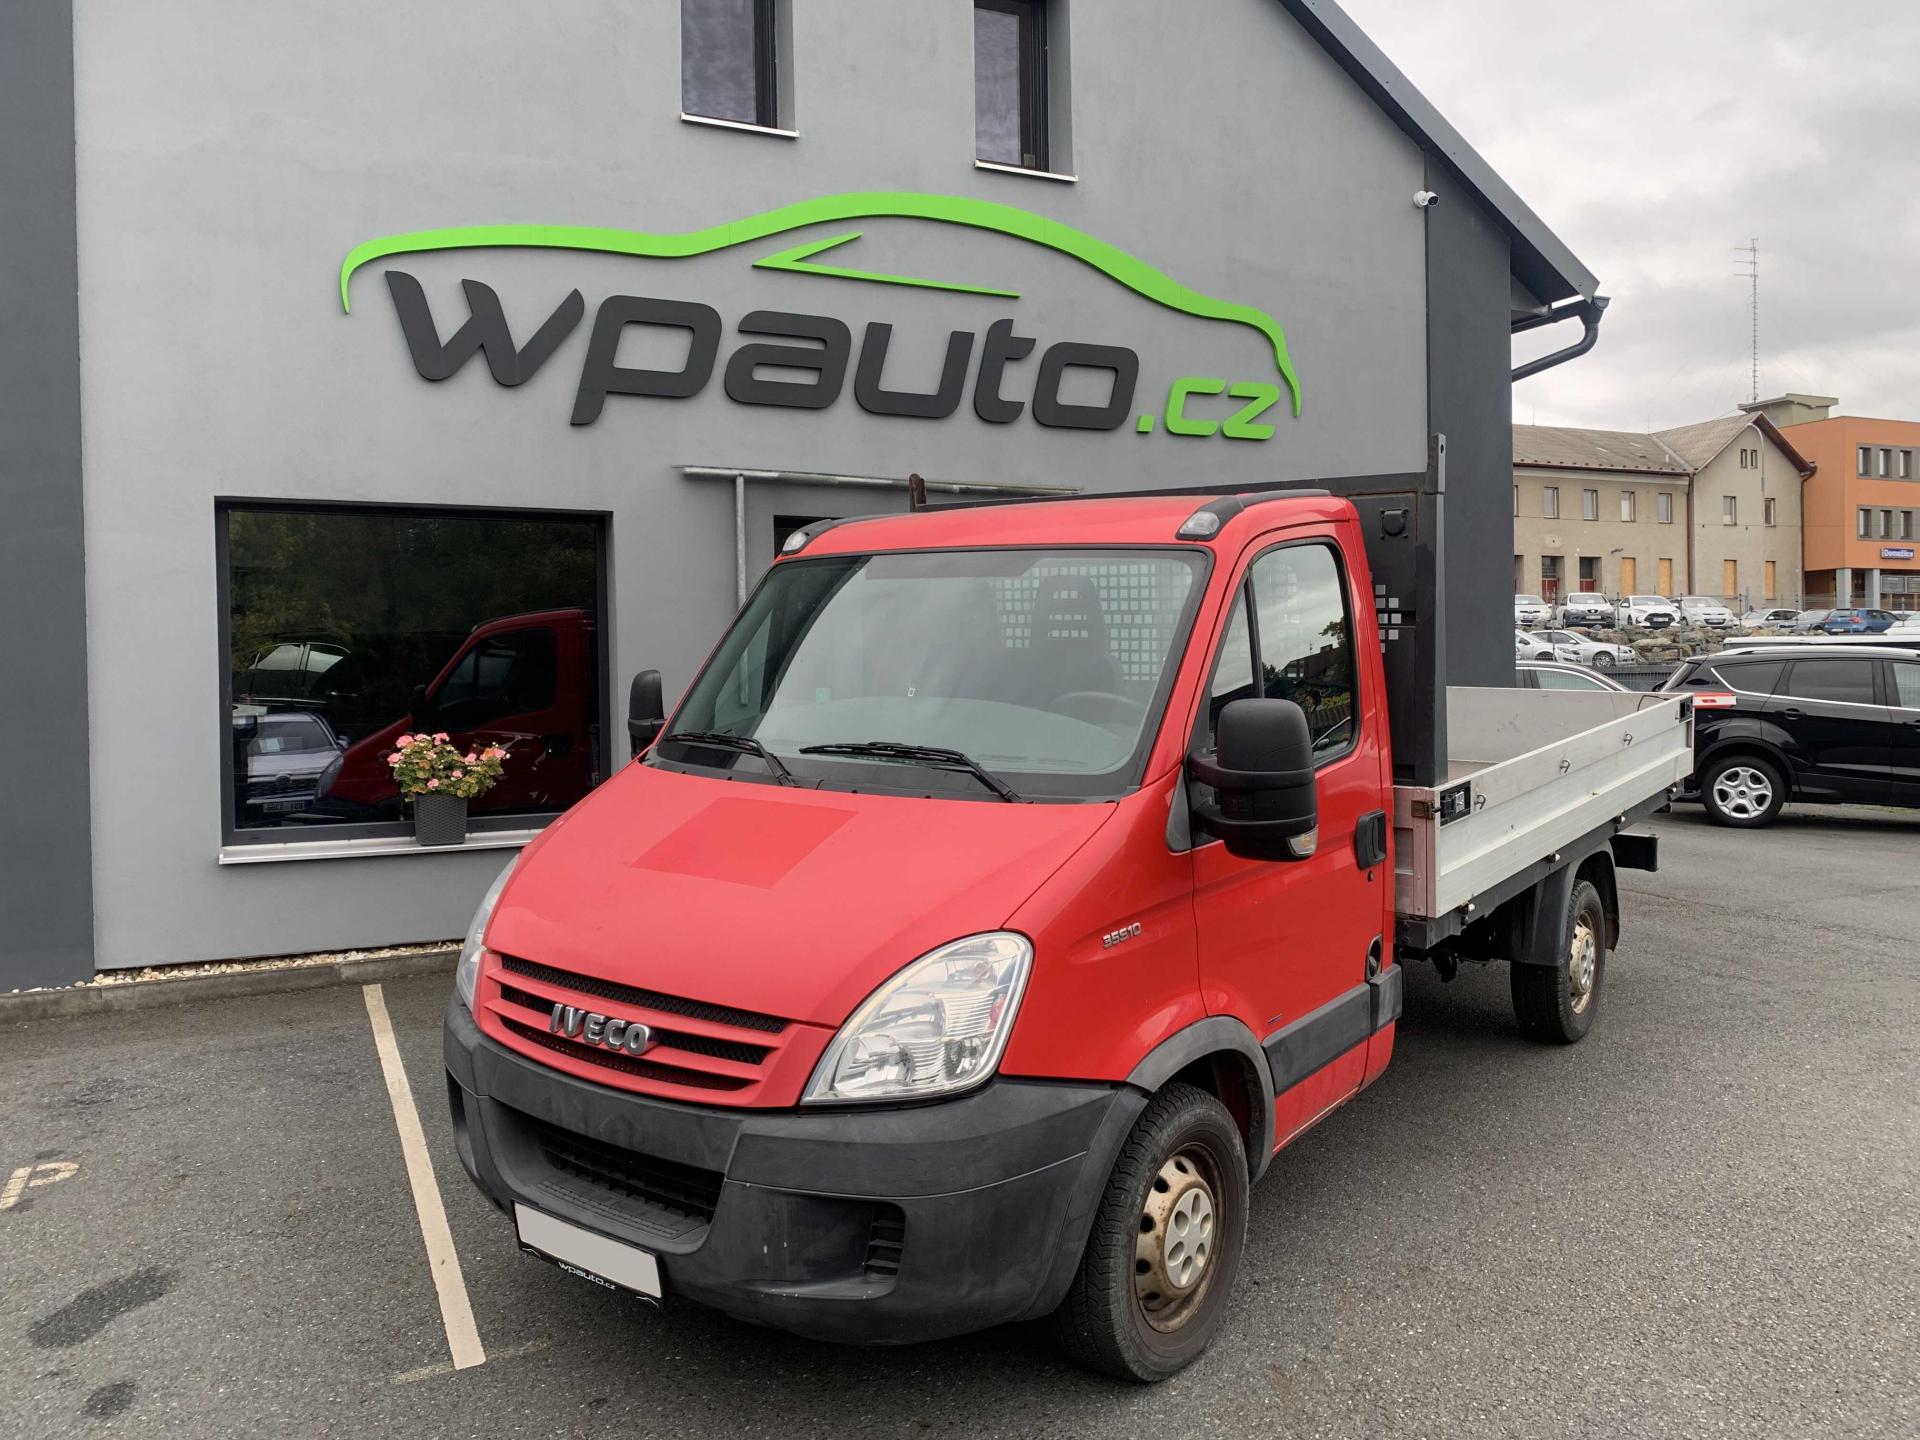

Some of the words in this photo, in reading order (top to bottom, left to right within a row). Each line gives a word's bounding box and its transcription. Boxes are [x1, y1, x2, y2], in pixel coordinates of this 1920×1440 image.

[385, 270, 1279, 441] wpauto.cz
[1103, 922, 1141, 949] 35S10
[549, 1003, 651, 1056] IVECO
[558, 1261, 616, 1290] wpauto.cz
